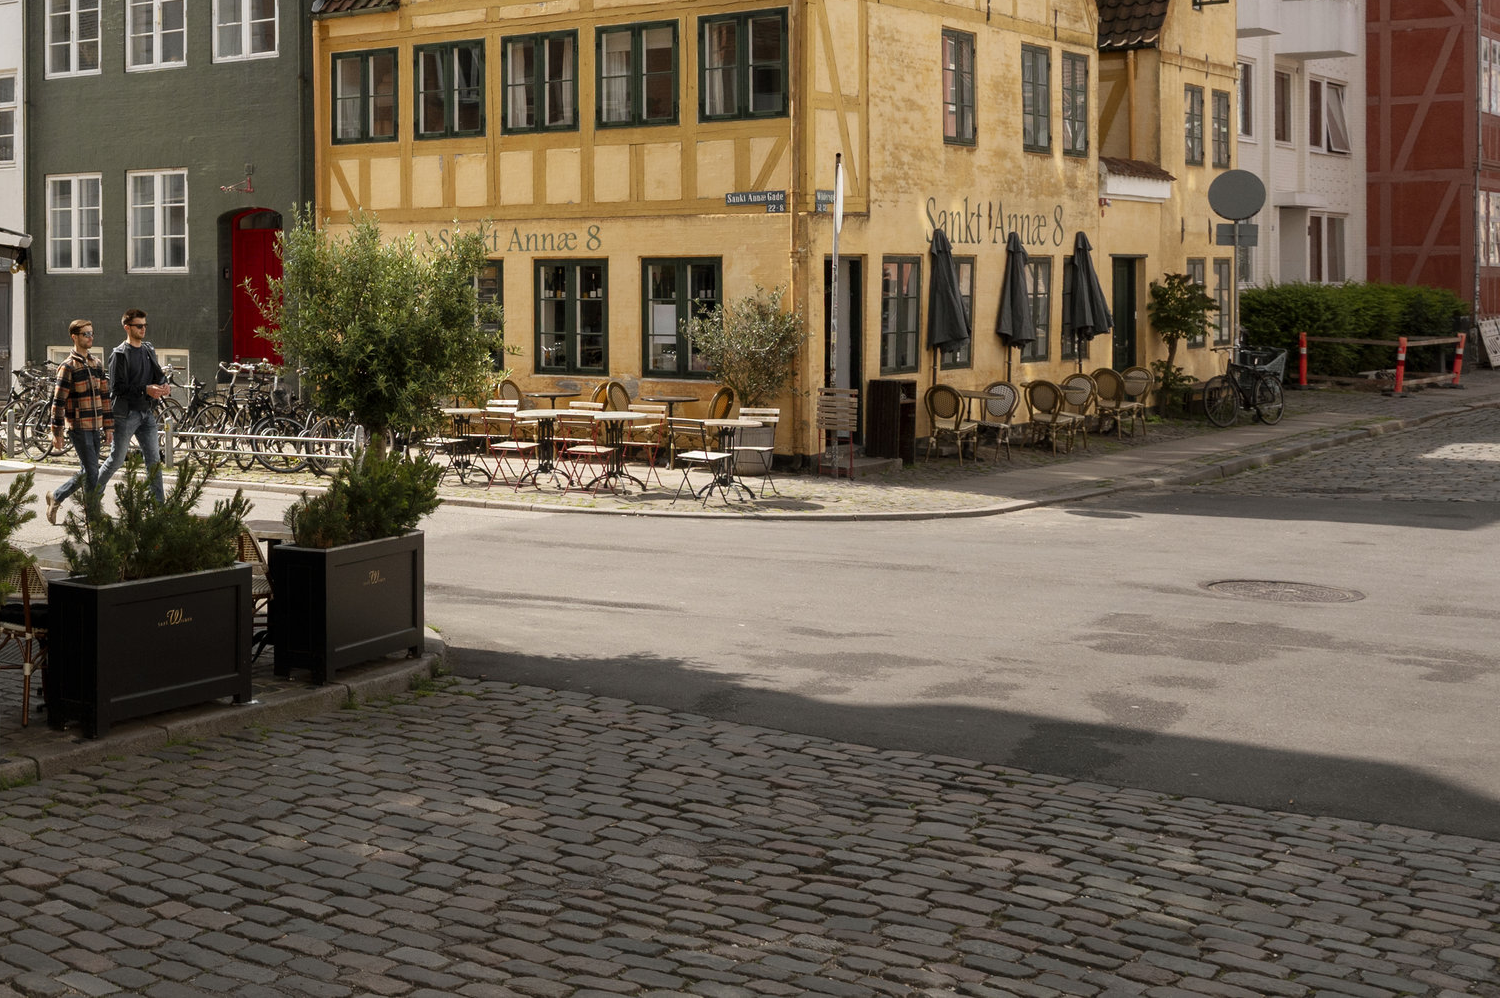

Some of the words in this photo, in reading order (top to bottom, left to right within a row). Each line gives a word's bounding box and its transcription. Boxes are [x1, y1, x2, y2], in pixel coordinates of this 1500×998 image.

[727, 193, 746, 203] Sankt
[767, 192, 784, 201] Gade
[992, 199, 1047, 246] Annæ
[1053, 204, 1064, 247] 8
[438, 226, 500, 253] Skt
[507, 227, 577, 252] Annæ
[586, 224, 602, 251] 8
